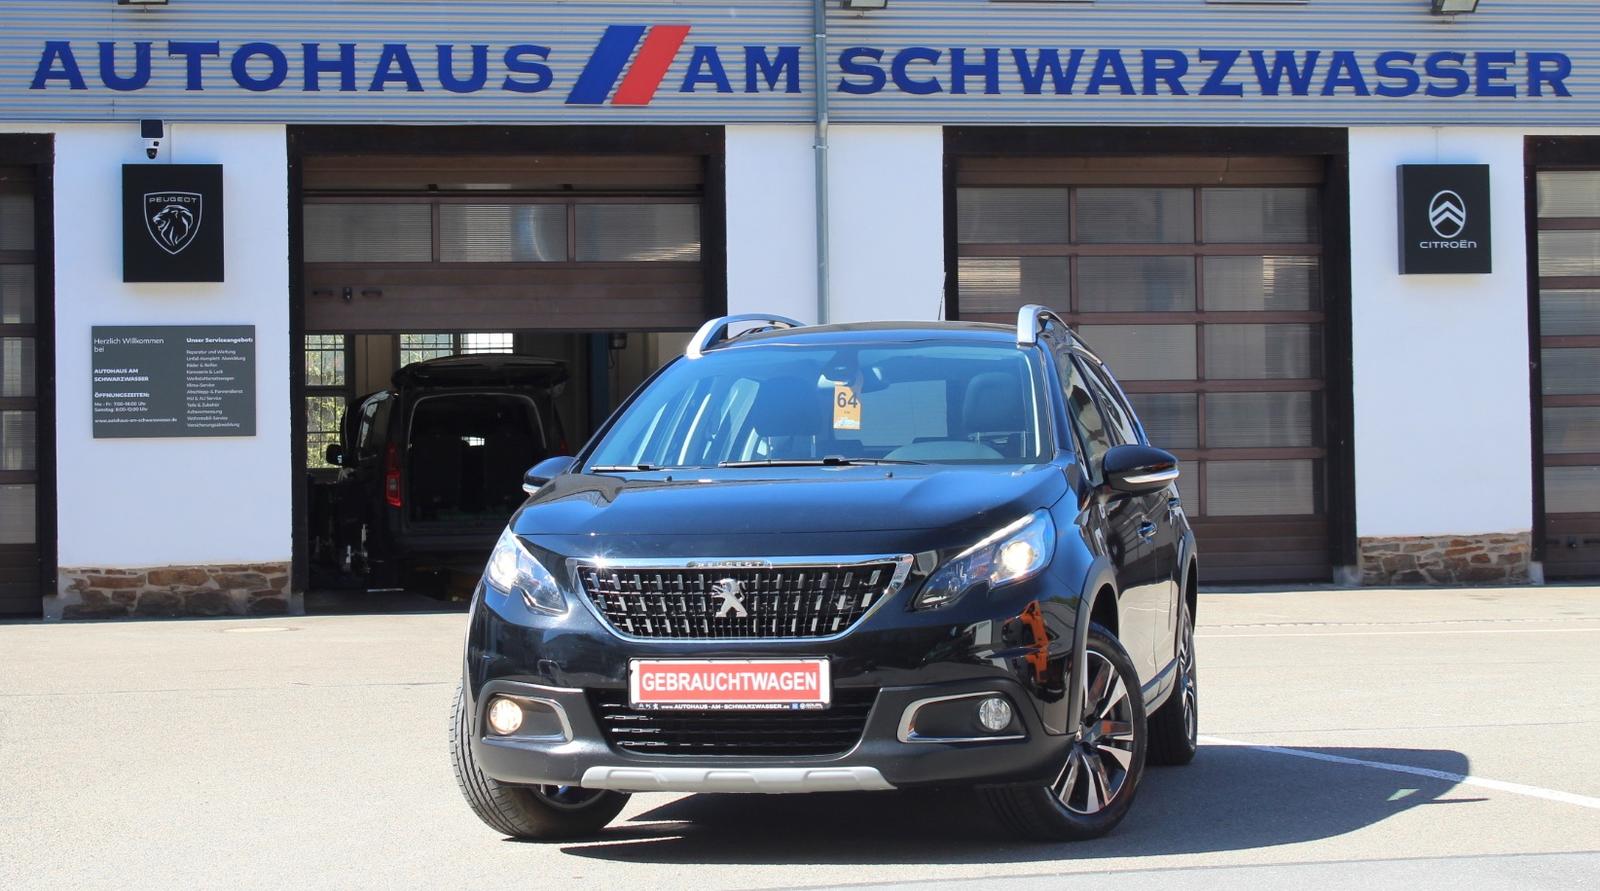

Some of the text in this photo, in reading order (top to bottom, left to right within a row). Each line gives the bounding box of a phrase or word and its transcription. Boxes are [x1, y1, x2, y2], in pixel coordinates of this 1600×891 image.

[29, 40, 1572, 98] AUTOHAUS AM SCHWARZWASSER
[1419, 239, 1478, 249] CITROËN
[94, 337, 164, 345] Herzlich Willkommen
[837, 391, 858, 409] 64
[642, 672, 817, 692] GEBRAUCHTWAGEN
